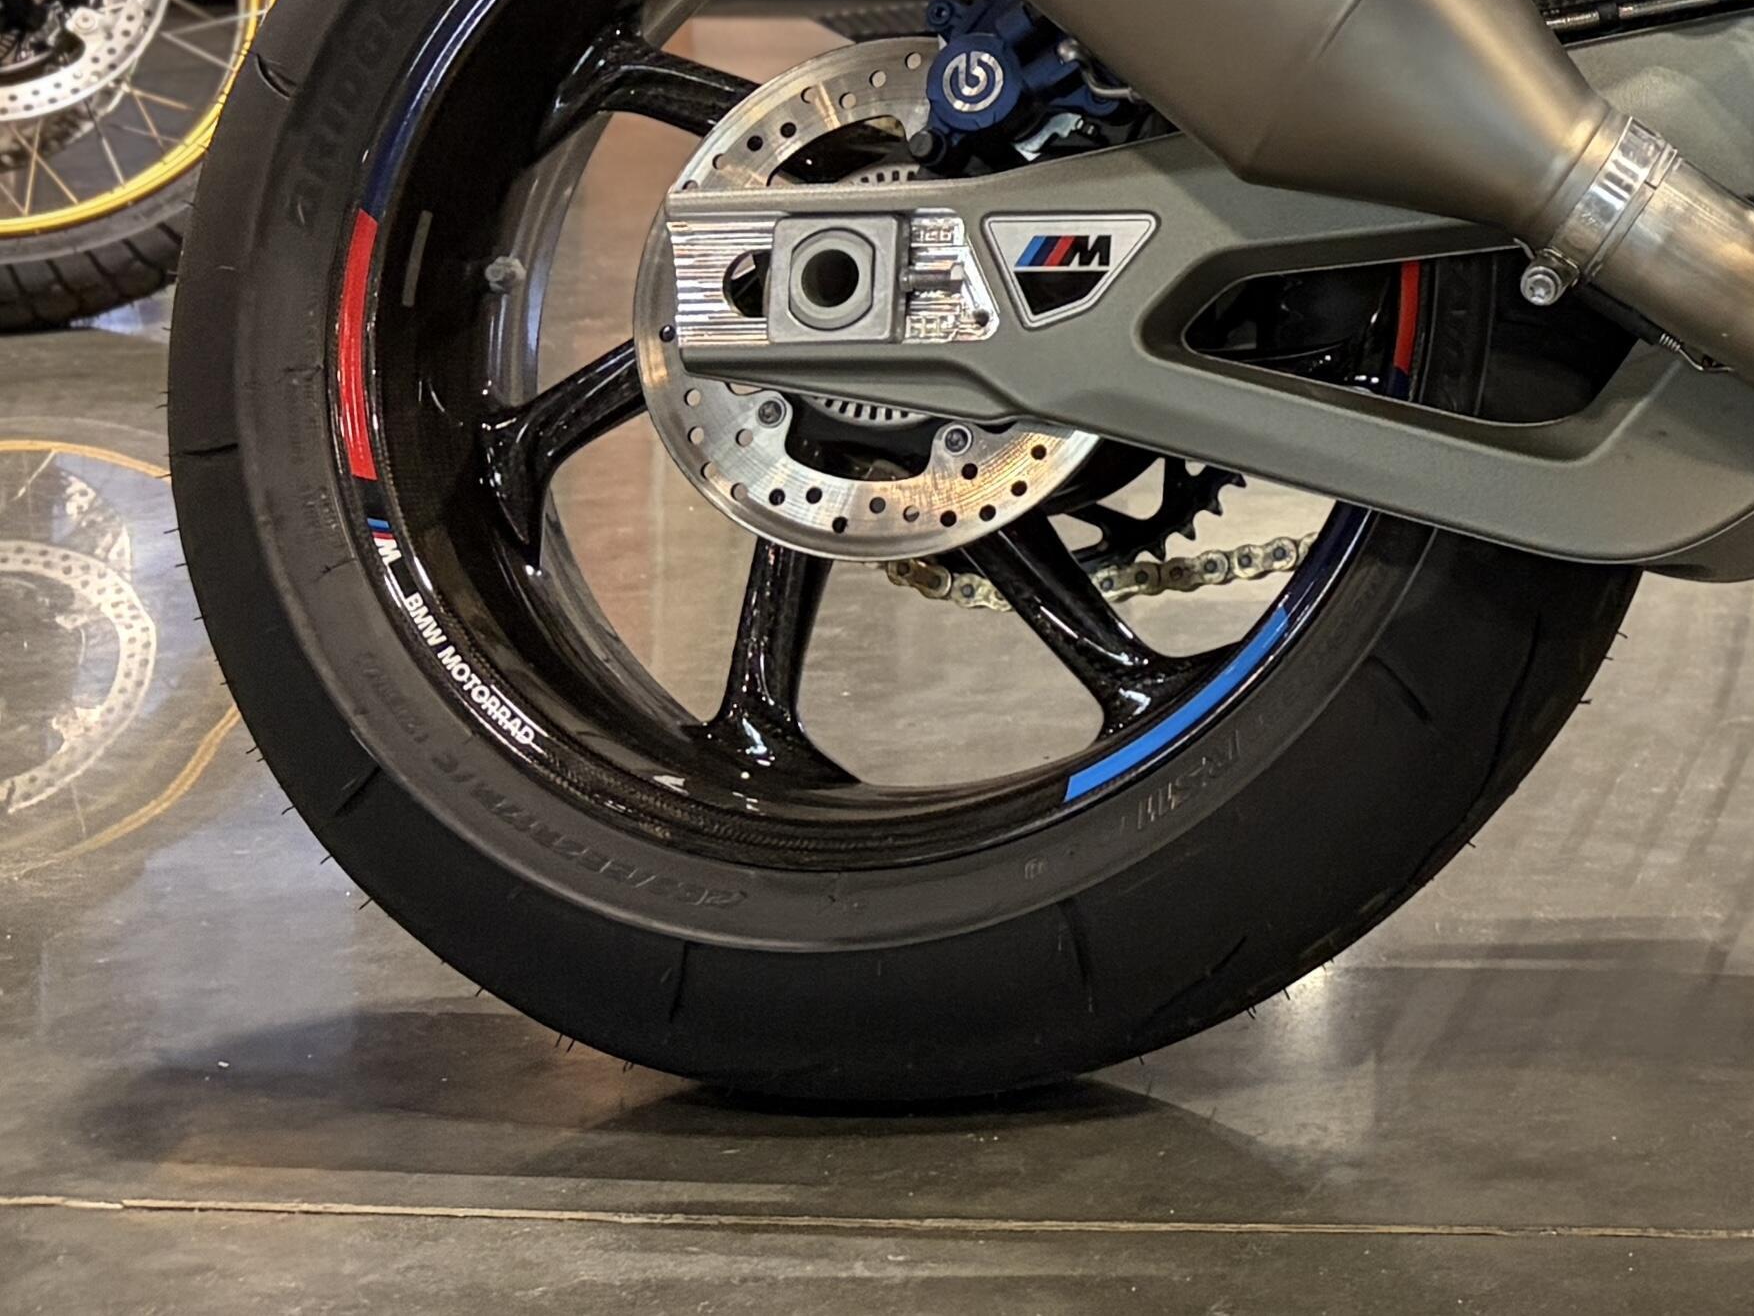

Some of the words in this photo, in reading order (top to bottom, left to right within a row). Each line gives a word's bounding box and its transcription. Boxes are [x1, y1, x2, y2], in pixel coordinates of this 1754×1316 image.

[373, 536, 402, 567] M
[403, 591, 448, 647] BMW
[437, 644, 536, 745] MOTORRAD
